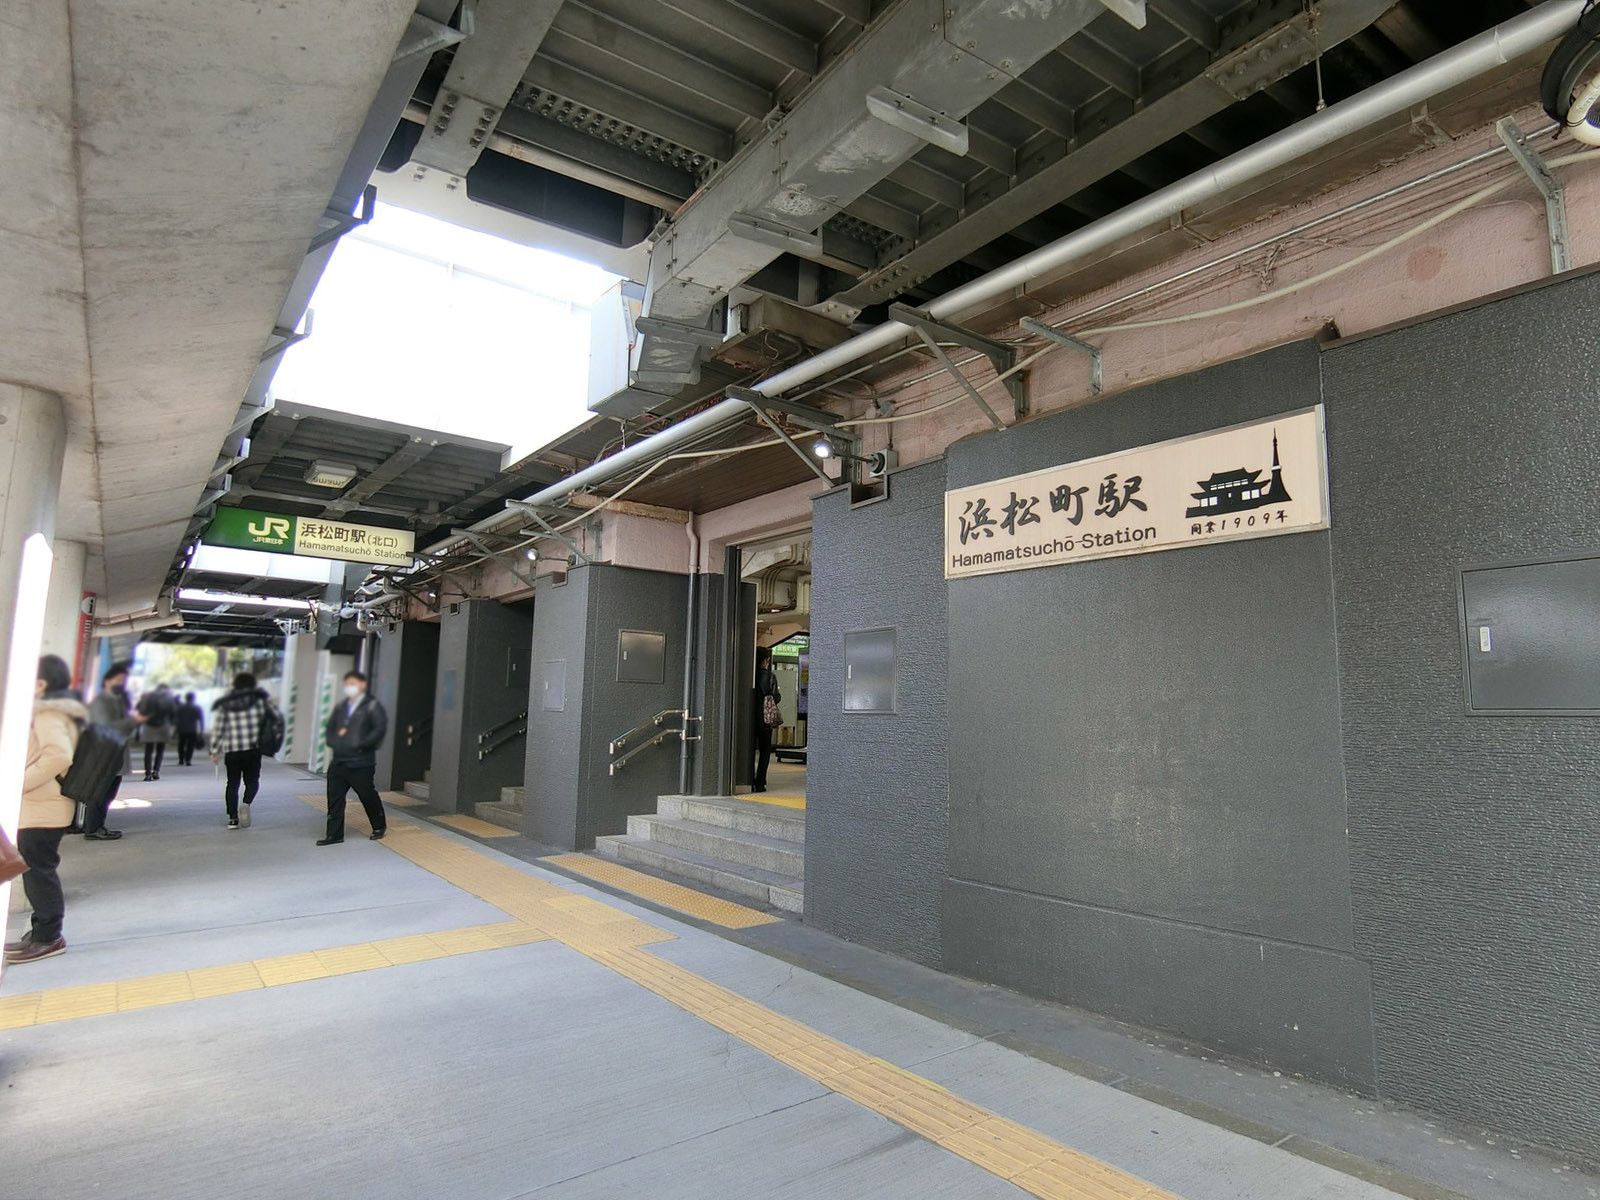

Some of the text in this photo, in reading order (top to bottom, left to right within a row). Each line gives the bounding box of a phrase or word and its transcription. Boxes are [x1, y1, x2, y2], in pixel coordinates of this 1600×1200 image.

[959, 474, 1148, 545] 浜松町駅
[248, 516, 290, 539] JR
[252, 536, 284, 545] JR東日本
[374, 549, 406, 560] Station
